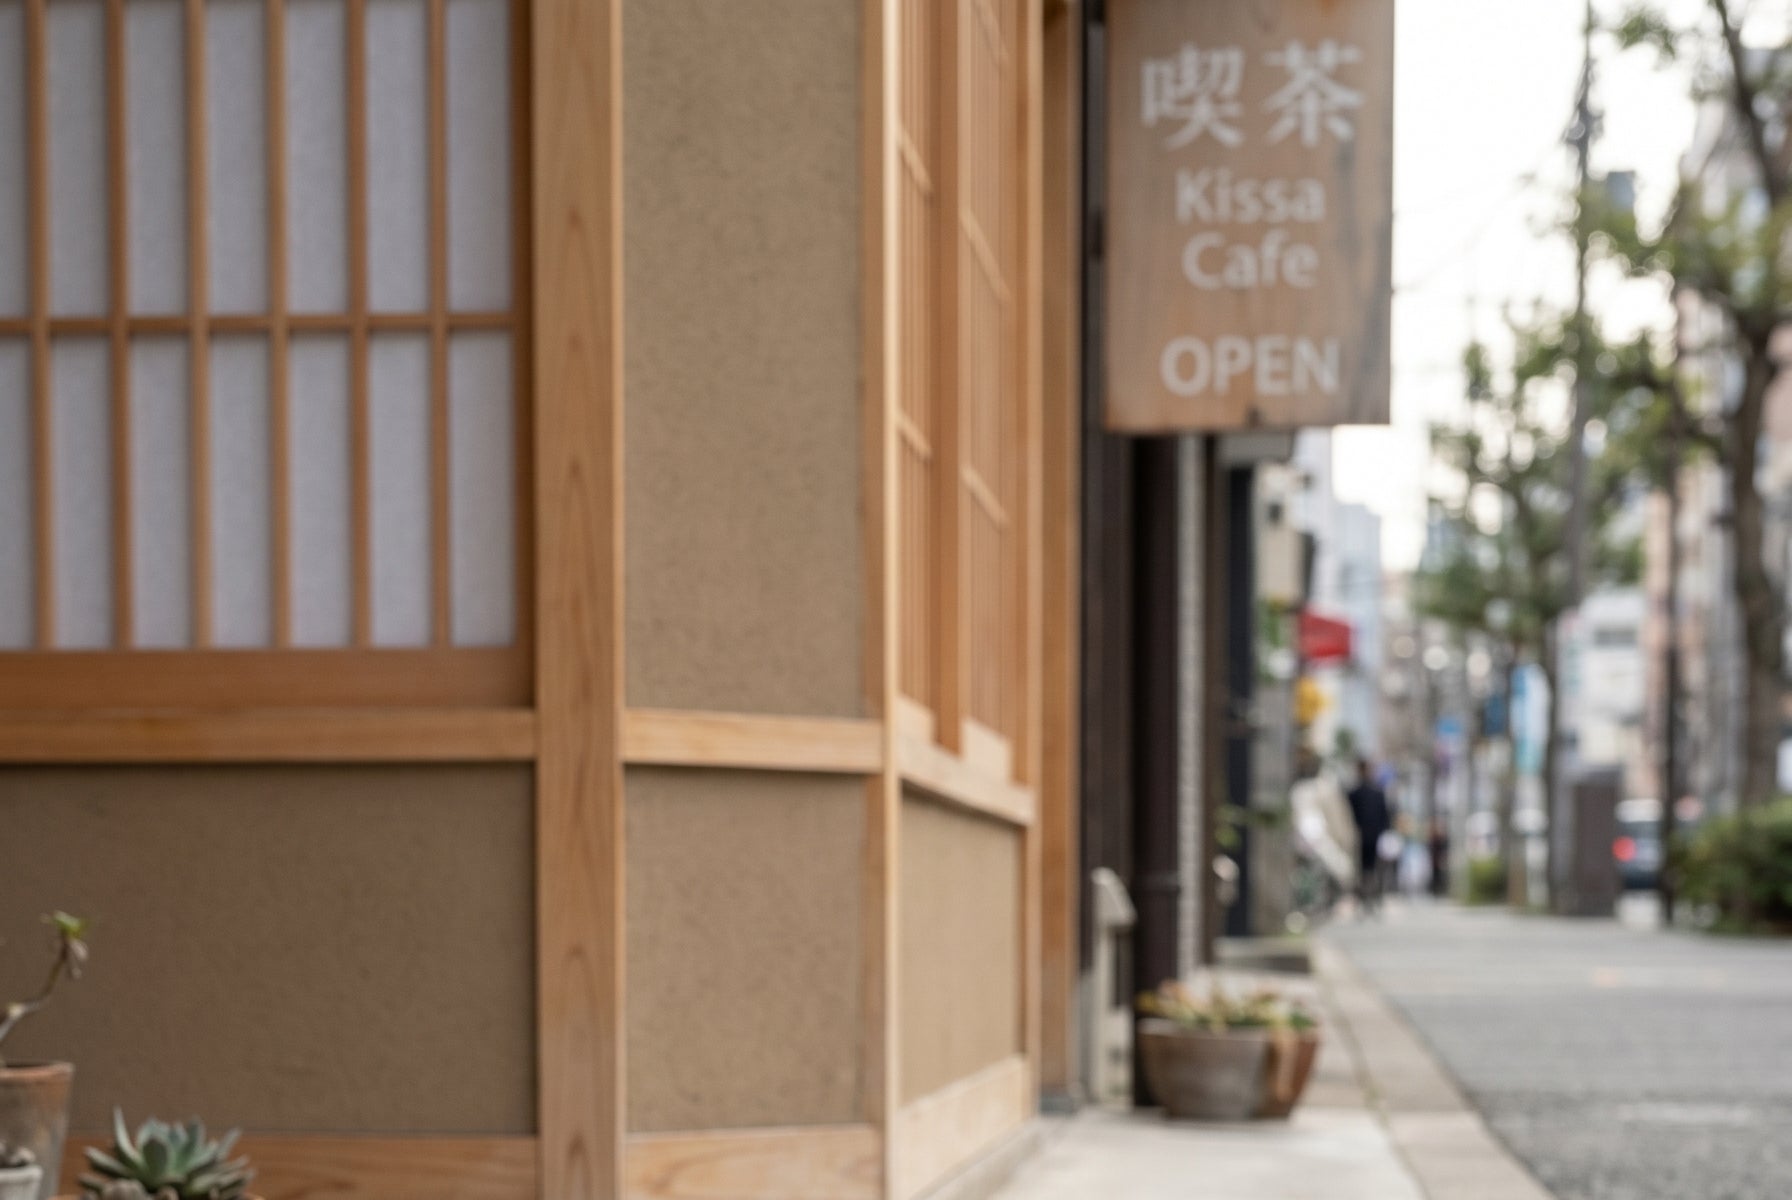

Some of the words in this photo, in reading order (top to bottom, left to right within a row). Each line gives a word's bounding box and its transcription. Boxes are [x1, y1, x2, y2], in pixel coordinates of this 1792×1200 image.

[1140, 39, 1363, 150] 喫茶
[1174, 167, 1326, 222] Kissa
[1181, 229, 1319, 290] Cafe
[1159, 334, 1340, 396] OPEN
